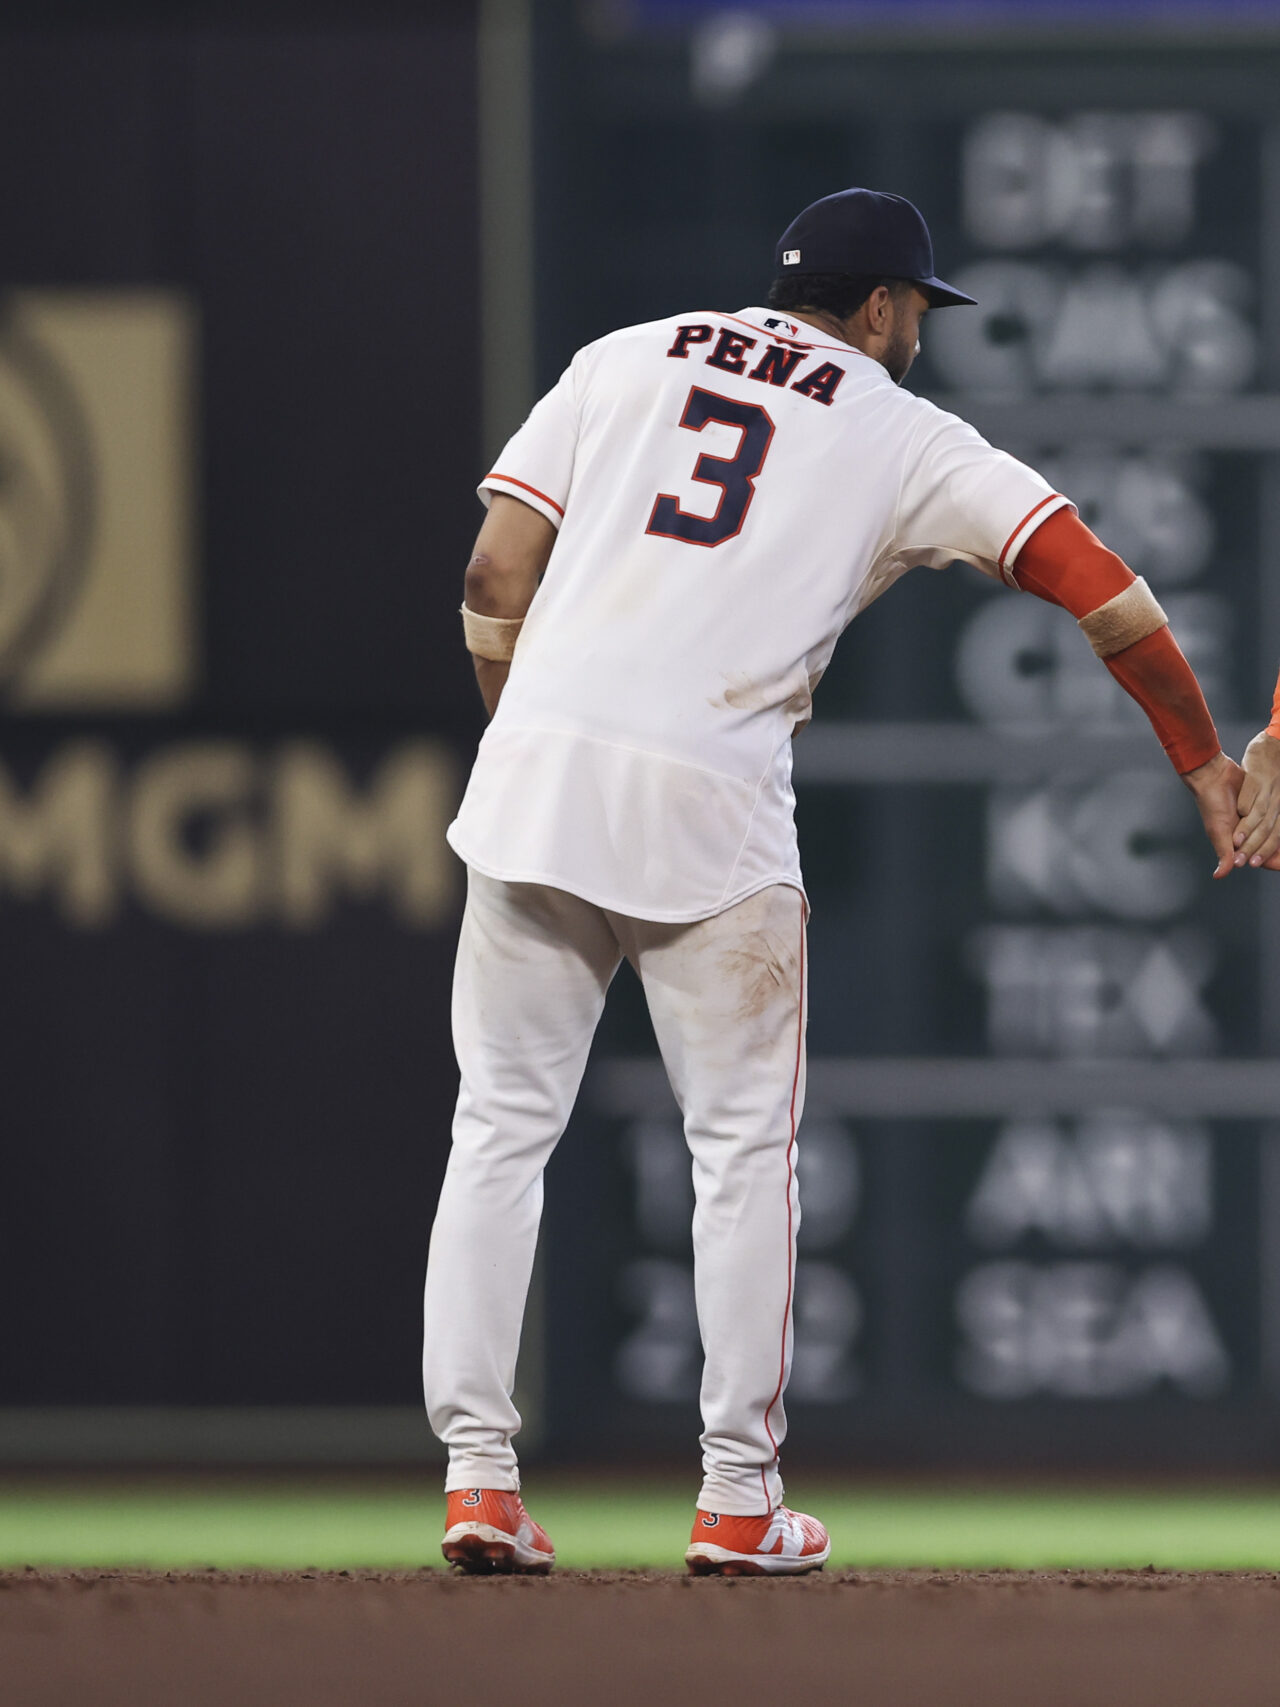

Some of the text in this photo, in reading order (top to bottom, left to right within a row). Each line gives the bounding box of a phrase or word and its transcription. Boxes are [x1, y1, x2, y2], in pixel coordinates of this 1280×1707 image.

[667, 324, 847, 406] PEÑA
[645, 385, 776, 548] 3
[957, 1260, 1230, 1398] SEA
[462, 1489, 482, 1507] 3
